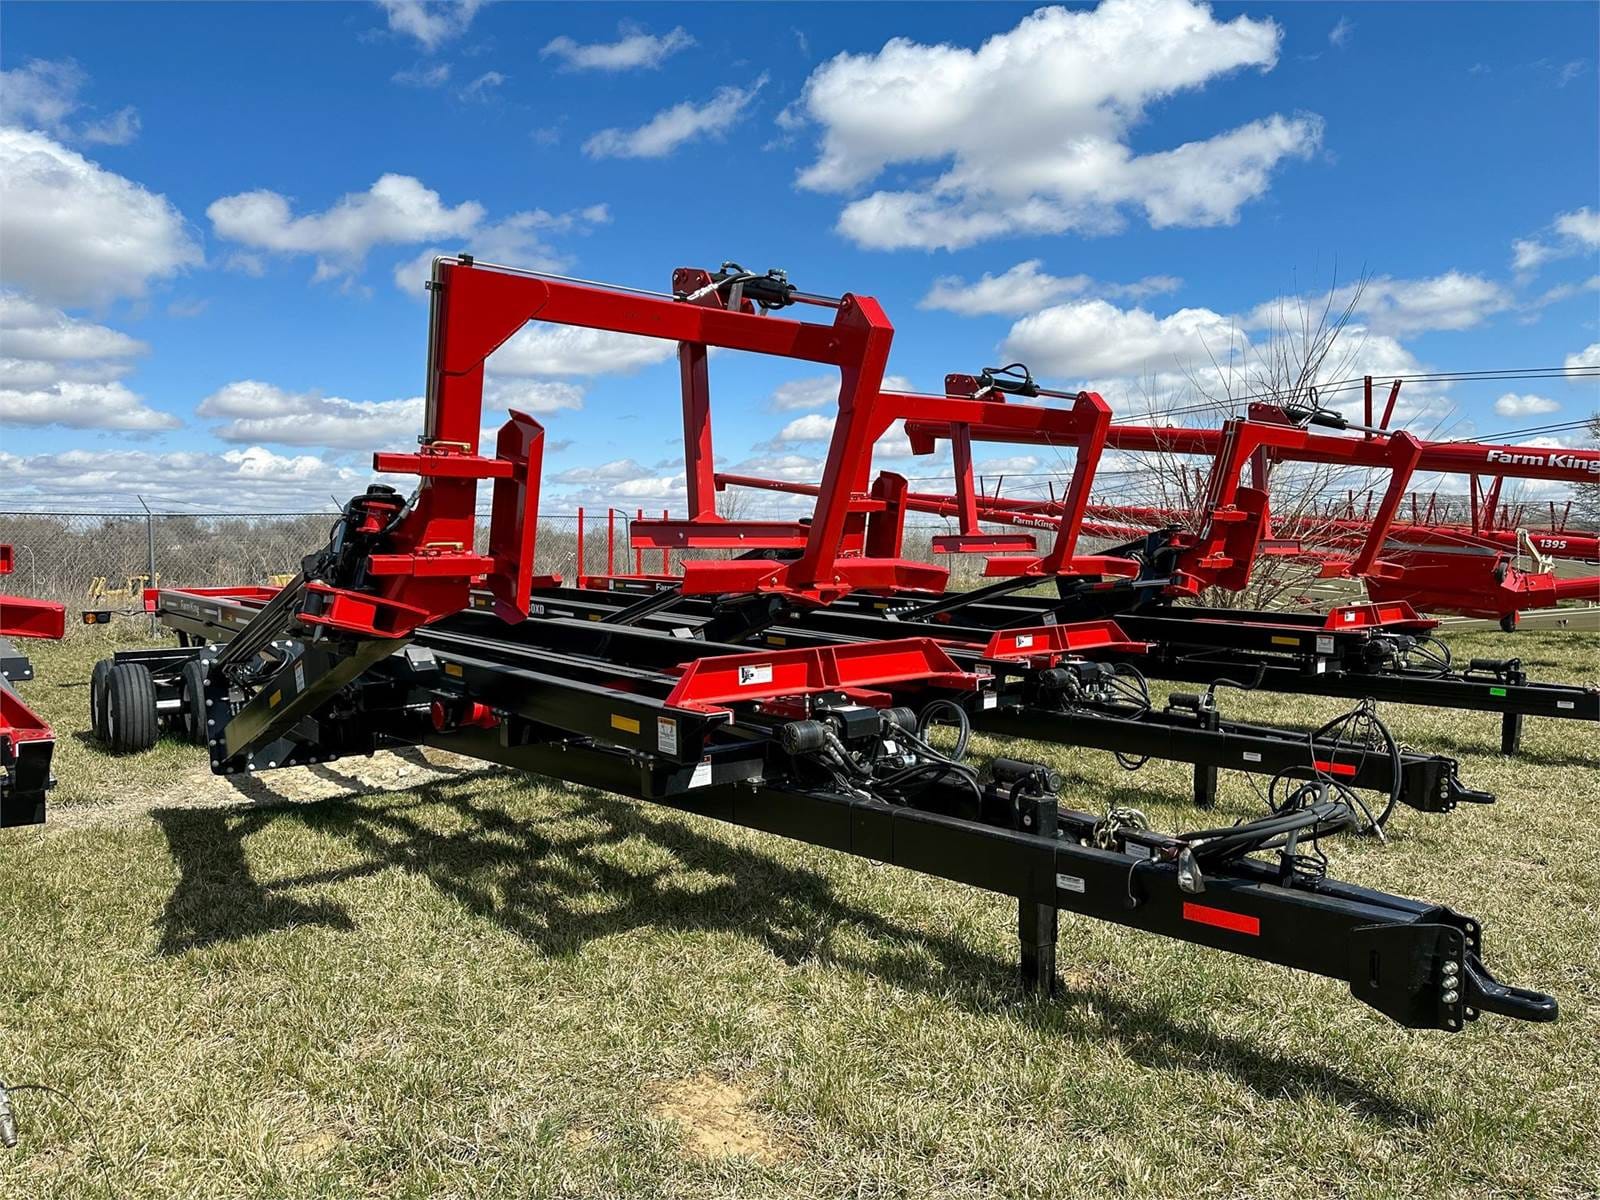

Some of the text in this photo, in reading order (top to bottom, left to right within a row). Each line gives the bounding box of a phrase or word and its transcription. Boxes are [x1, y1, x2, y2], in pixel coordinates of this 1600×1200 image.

[1486, 449, 1600, 474] Farm King
[1012, 515, 1054, 530] Farm King
[1539, 539, 1567, 549] 1395
[528, 603, 545, 615] 0XD
